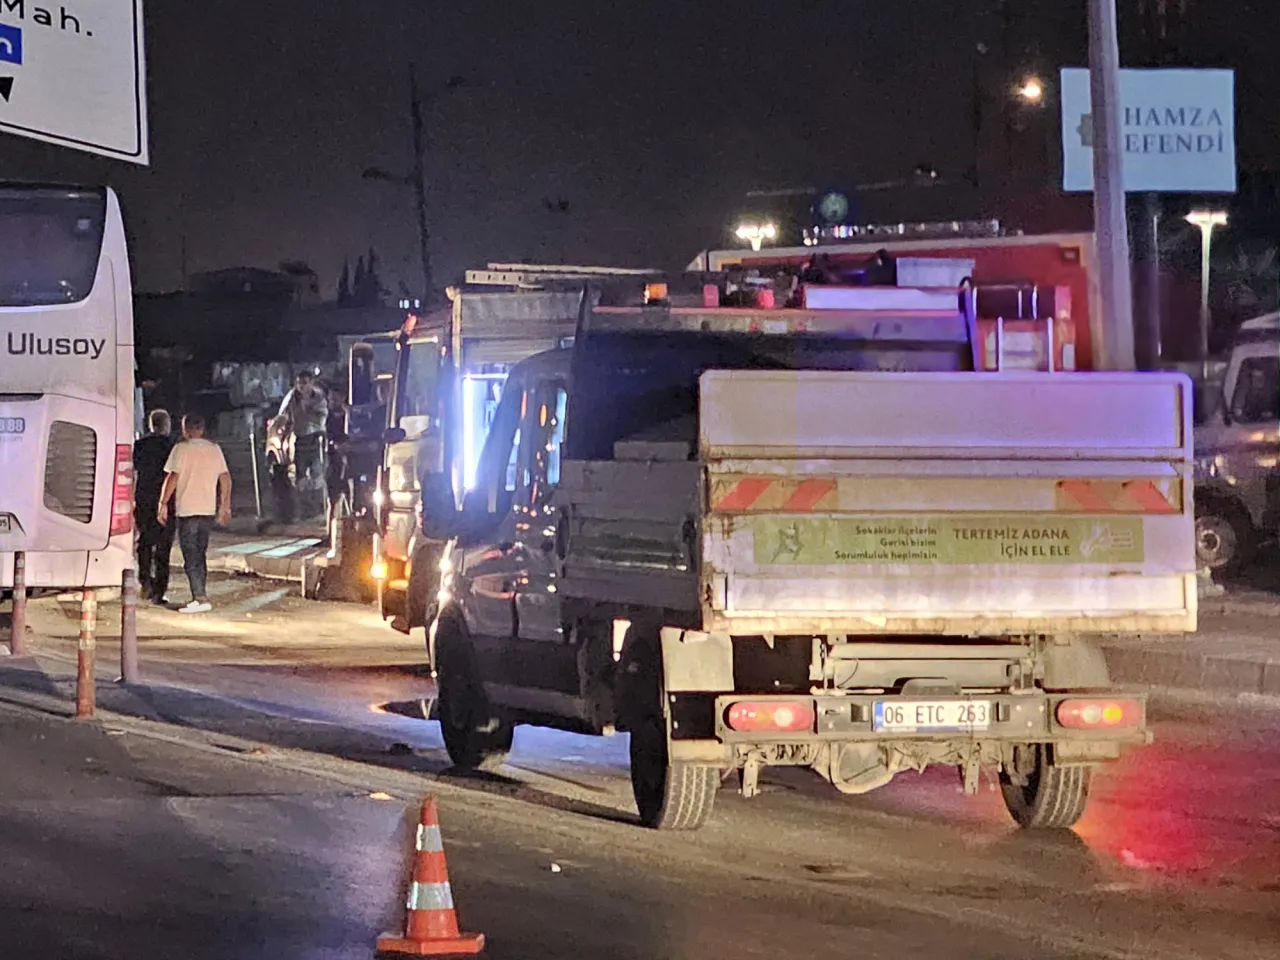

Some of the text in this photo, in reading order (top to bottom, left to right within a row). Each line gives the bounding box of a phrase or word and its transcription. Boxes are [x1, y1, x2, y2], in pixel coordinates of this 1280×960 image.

[1123, 106, 1224, 126] HAMZA
[1123, 129, 1225, 153] EFENDİ
[7, 332, 106, 360] Ulusoy
[953, 526, 1070, 540] TERTEMİZ ADANA
[1000, 542, 1071, 559] İÇİN EL ELE
[884, 704, 987, 724] 06 ETC 263
